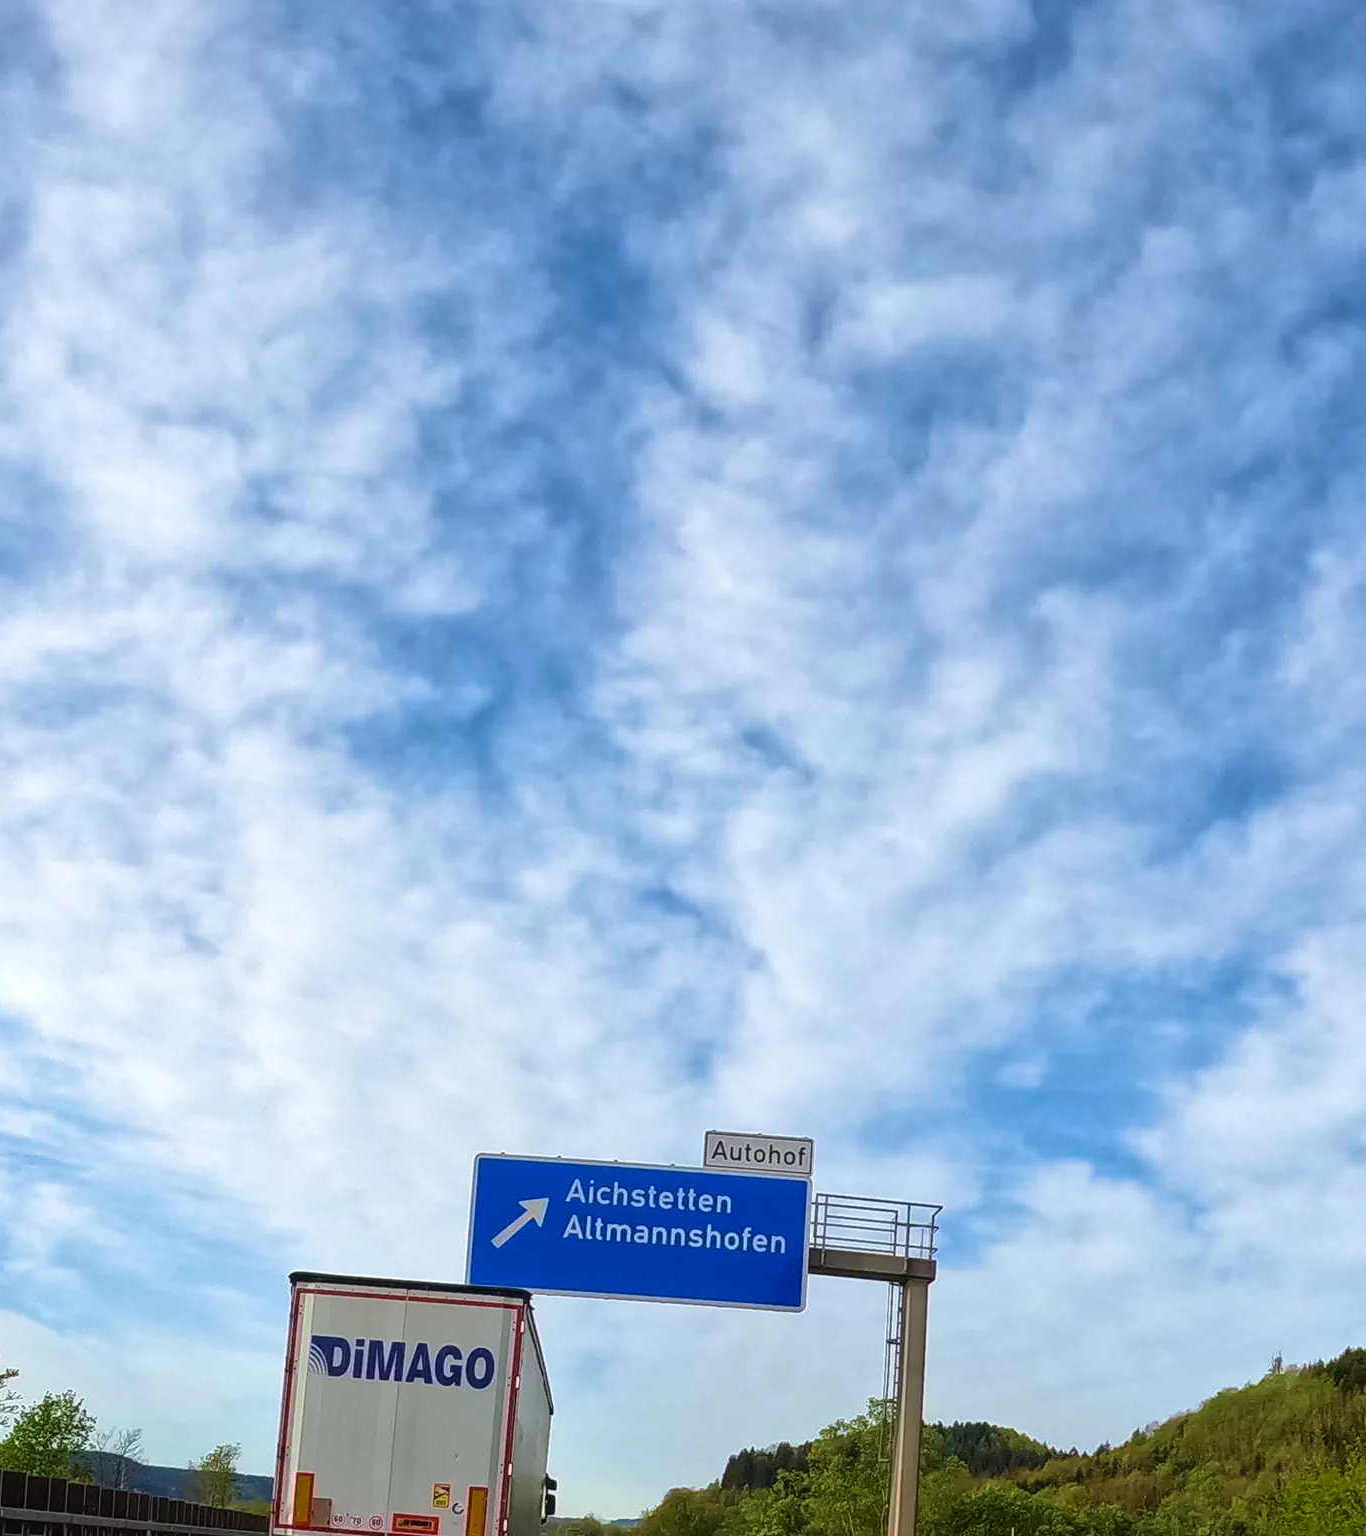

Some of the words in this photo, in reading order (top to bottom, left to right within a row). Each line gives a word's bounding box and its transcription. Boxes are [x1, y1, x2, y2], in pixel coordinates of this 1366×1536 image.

[711, 1140, 806, 1166] Autohof
[565, 1178, 732, 1214] Aichstetten
[563, 1214, 786, 1254] Altmannshofen
